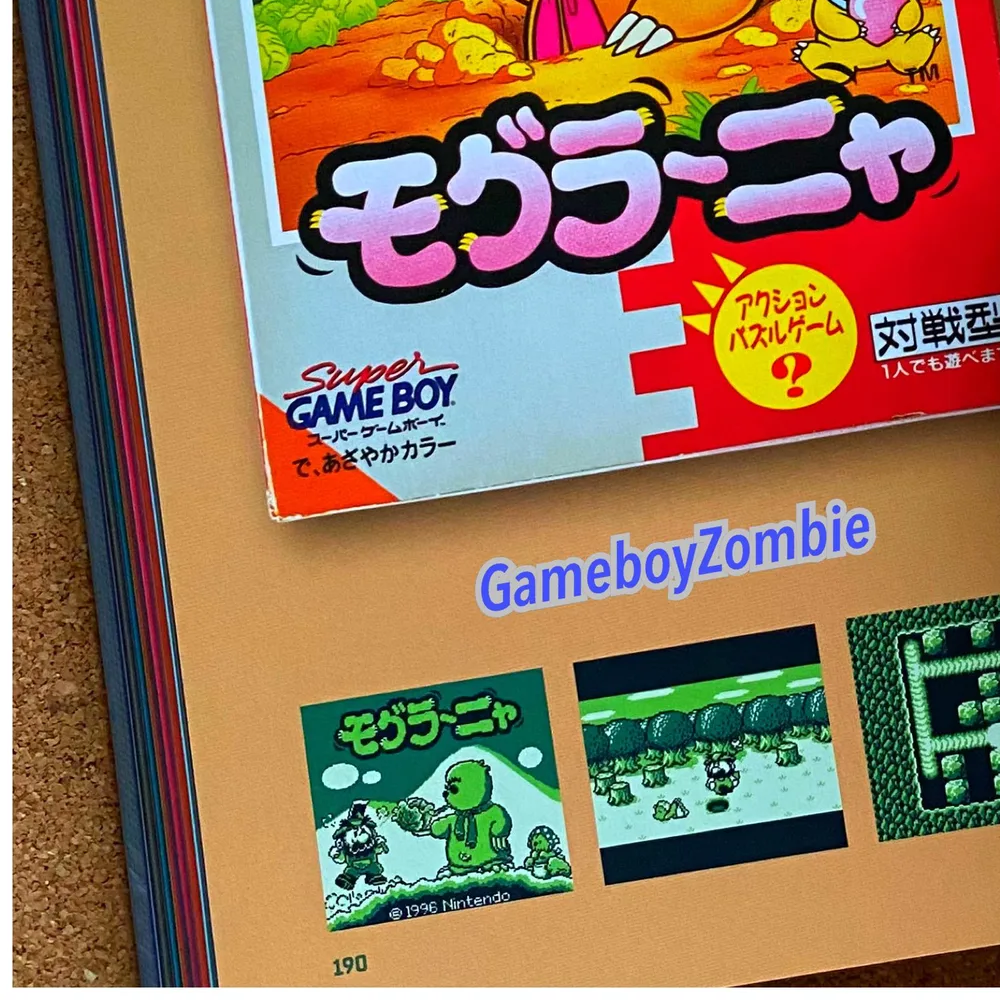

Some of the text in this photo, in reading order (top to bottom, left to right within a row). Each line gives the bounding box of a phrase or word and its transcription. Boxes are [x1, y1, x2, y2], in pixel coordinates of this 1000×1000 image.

[735, 283, 827, 321] アクション
[729, 311, 844, 352] パズルゲーム
[283, 351, 460, 400] Super
[286, 373, 459, 430] GAME BOY
[405, 901, 438, 918] 1996
[442, 891, 511, 912] Nintendo
[332, 954, 368, 977] 190
